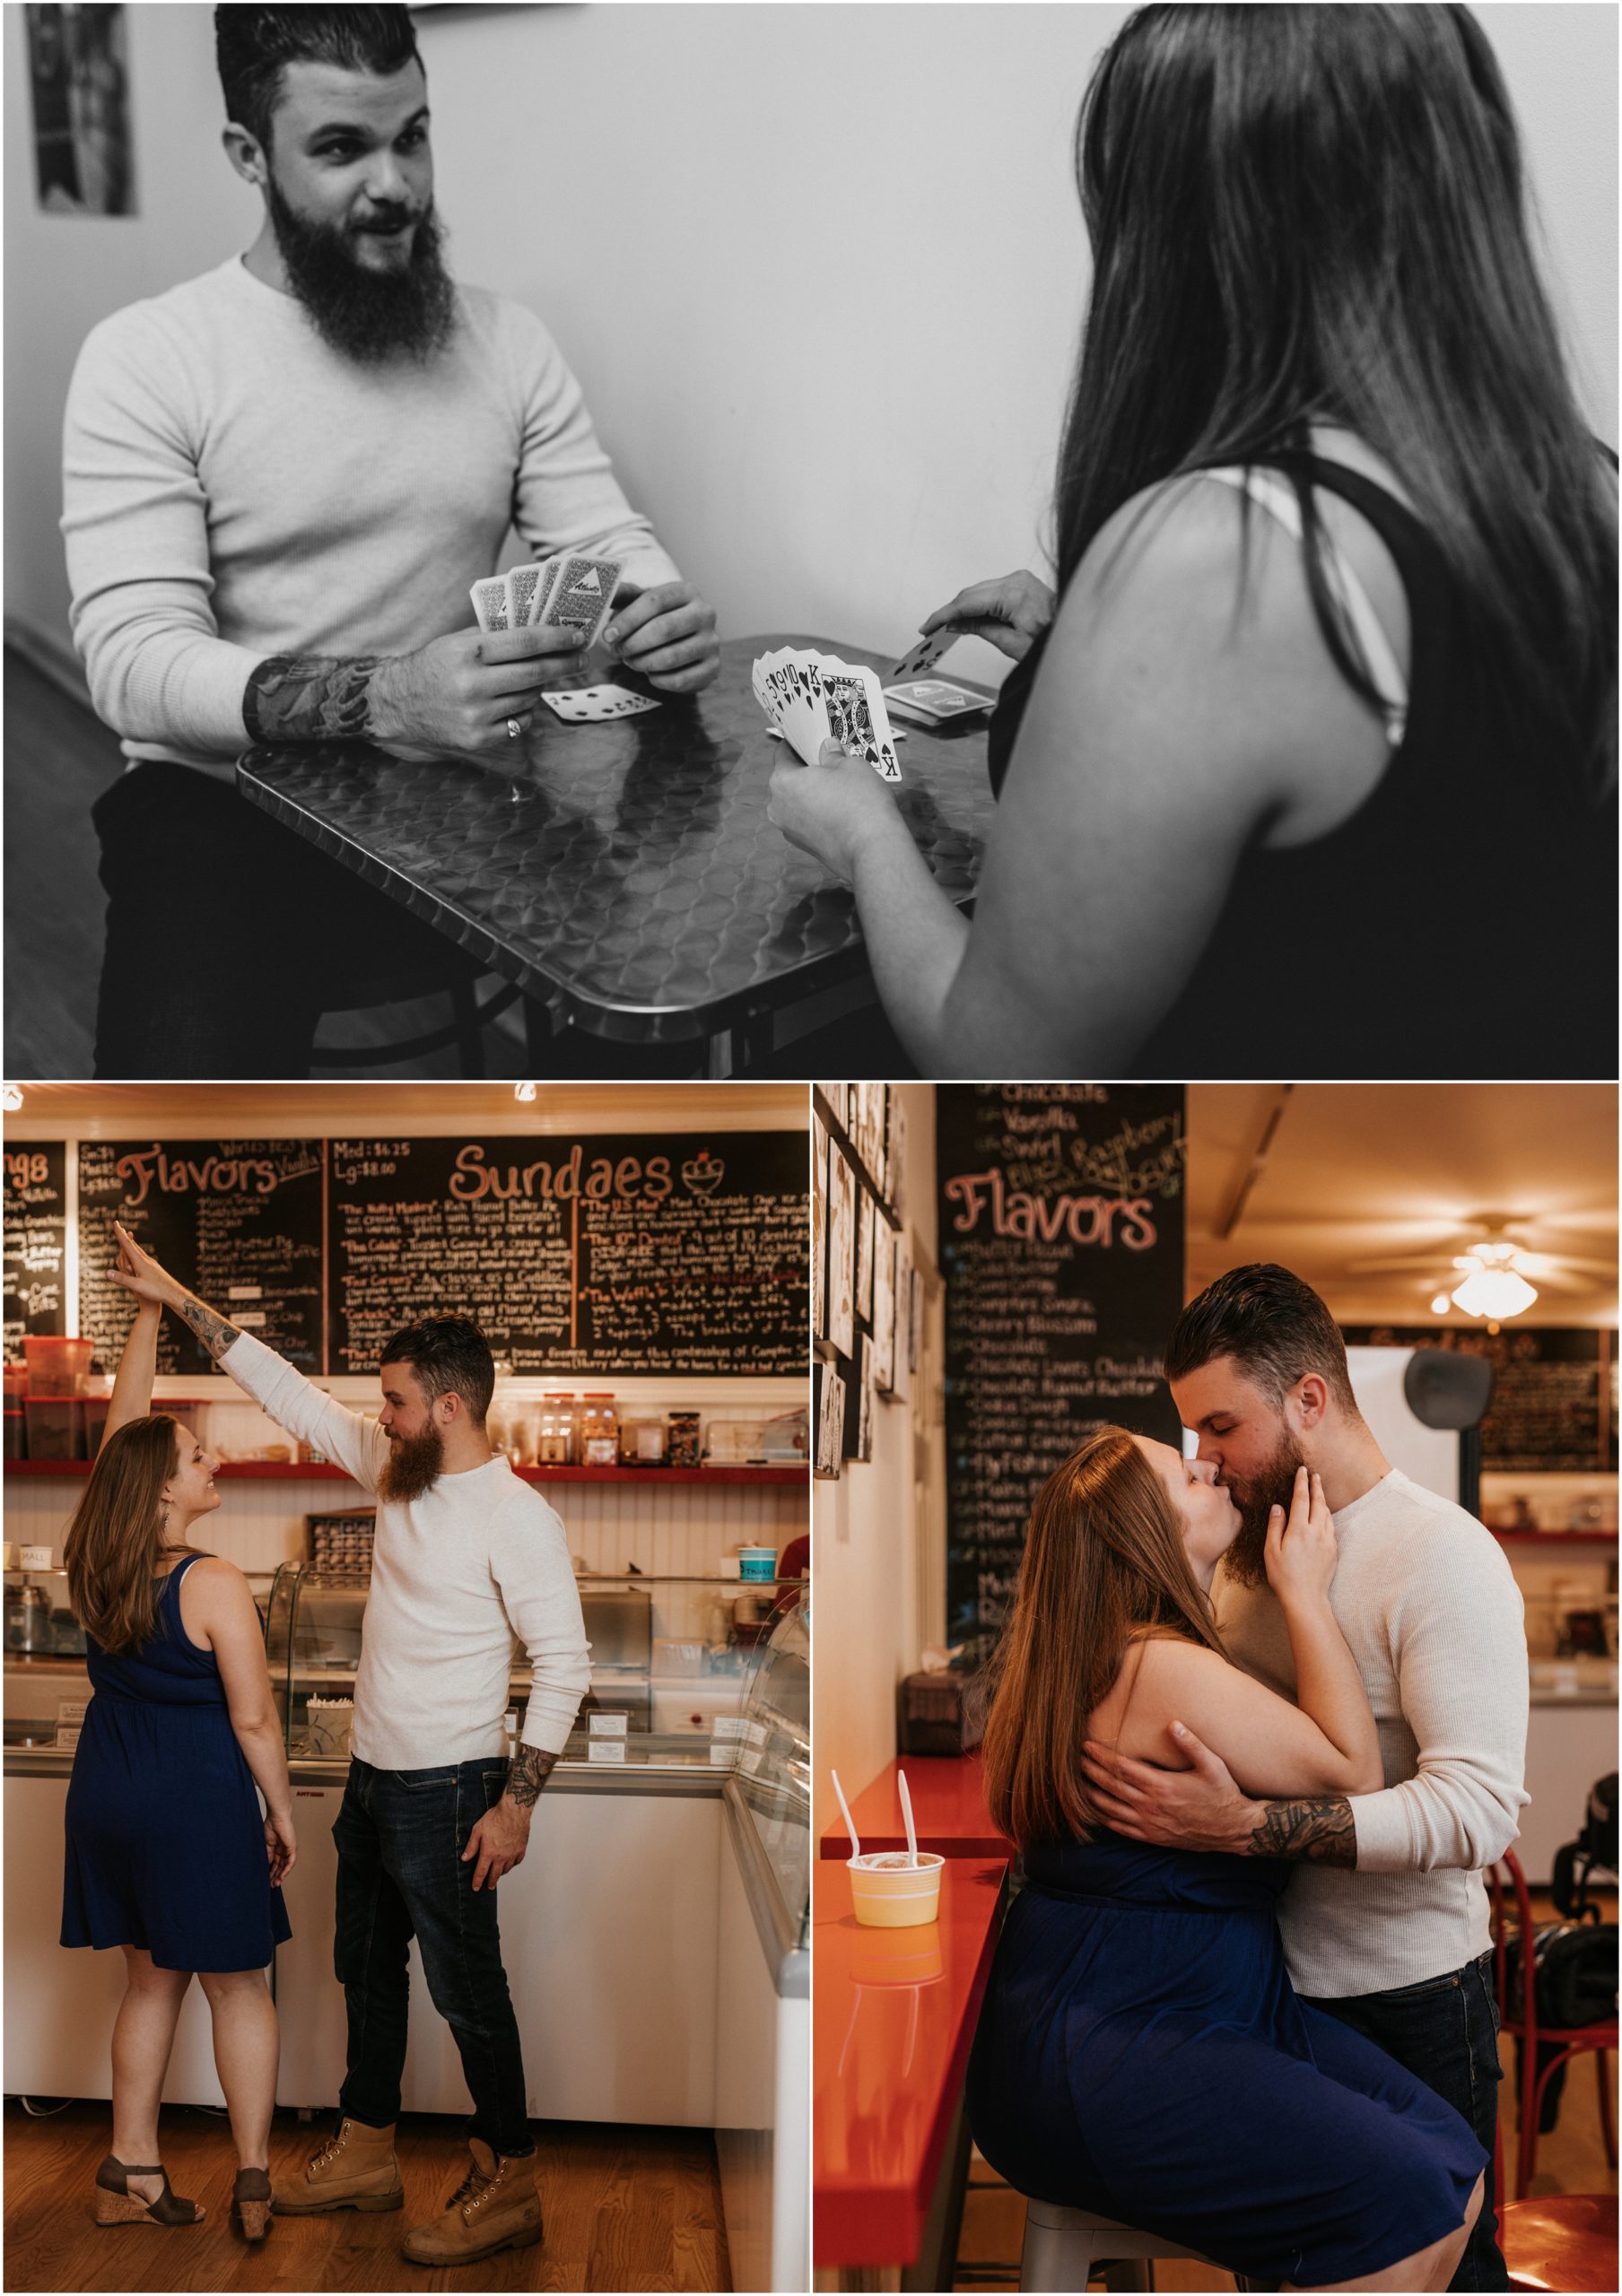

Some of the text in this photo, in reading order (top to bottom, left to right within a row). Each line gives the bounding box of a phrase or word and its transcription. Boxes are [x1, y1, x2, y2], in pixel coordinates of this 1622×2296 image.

[776, 671, 787, 691] 9
[786, 664, 798, 684] 10
[807, 664, 821, 686] K
[765, 678, 778, 700] 5
[881, 756, 898, 777] K
[1002, 1106, 1079, 1133] Vanilla
[117, 1144, 278, 1206] Flavors
[449, 1144, 673, 1200] Sundaes
[945, 1168, 1157, 1250] Flavors
